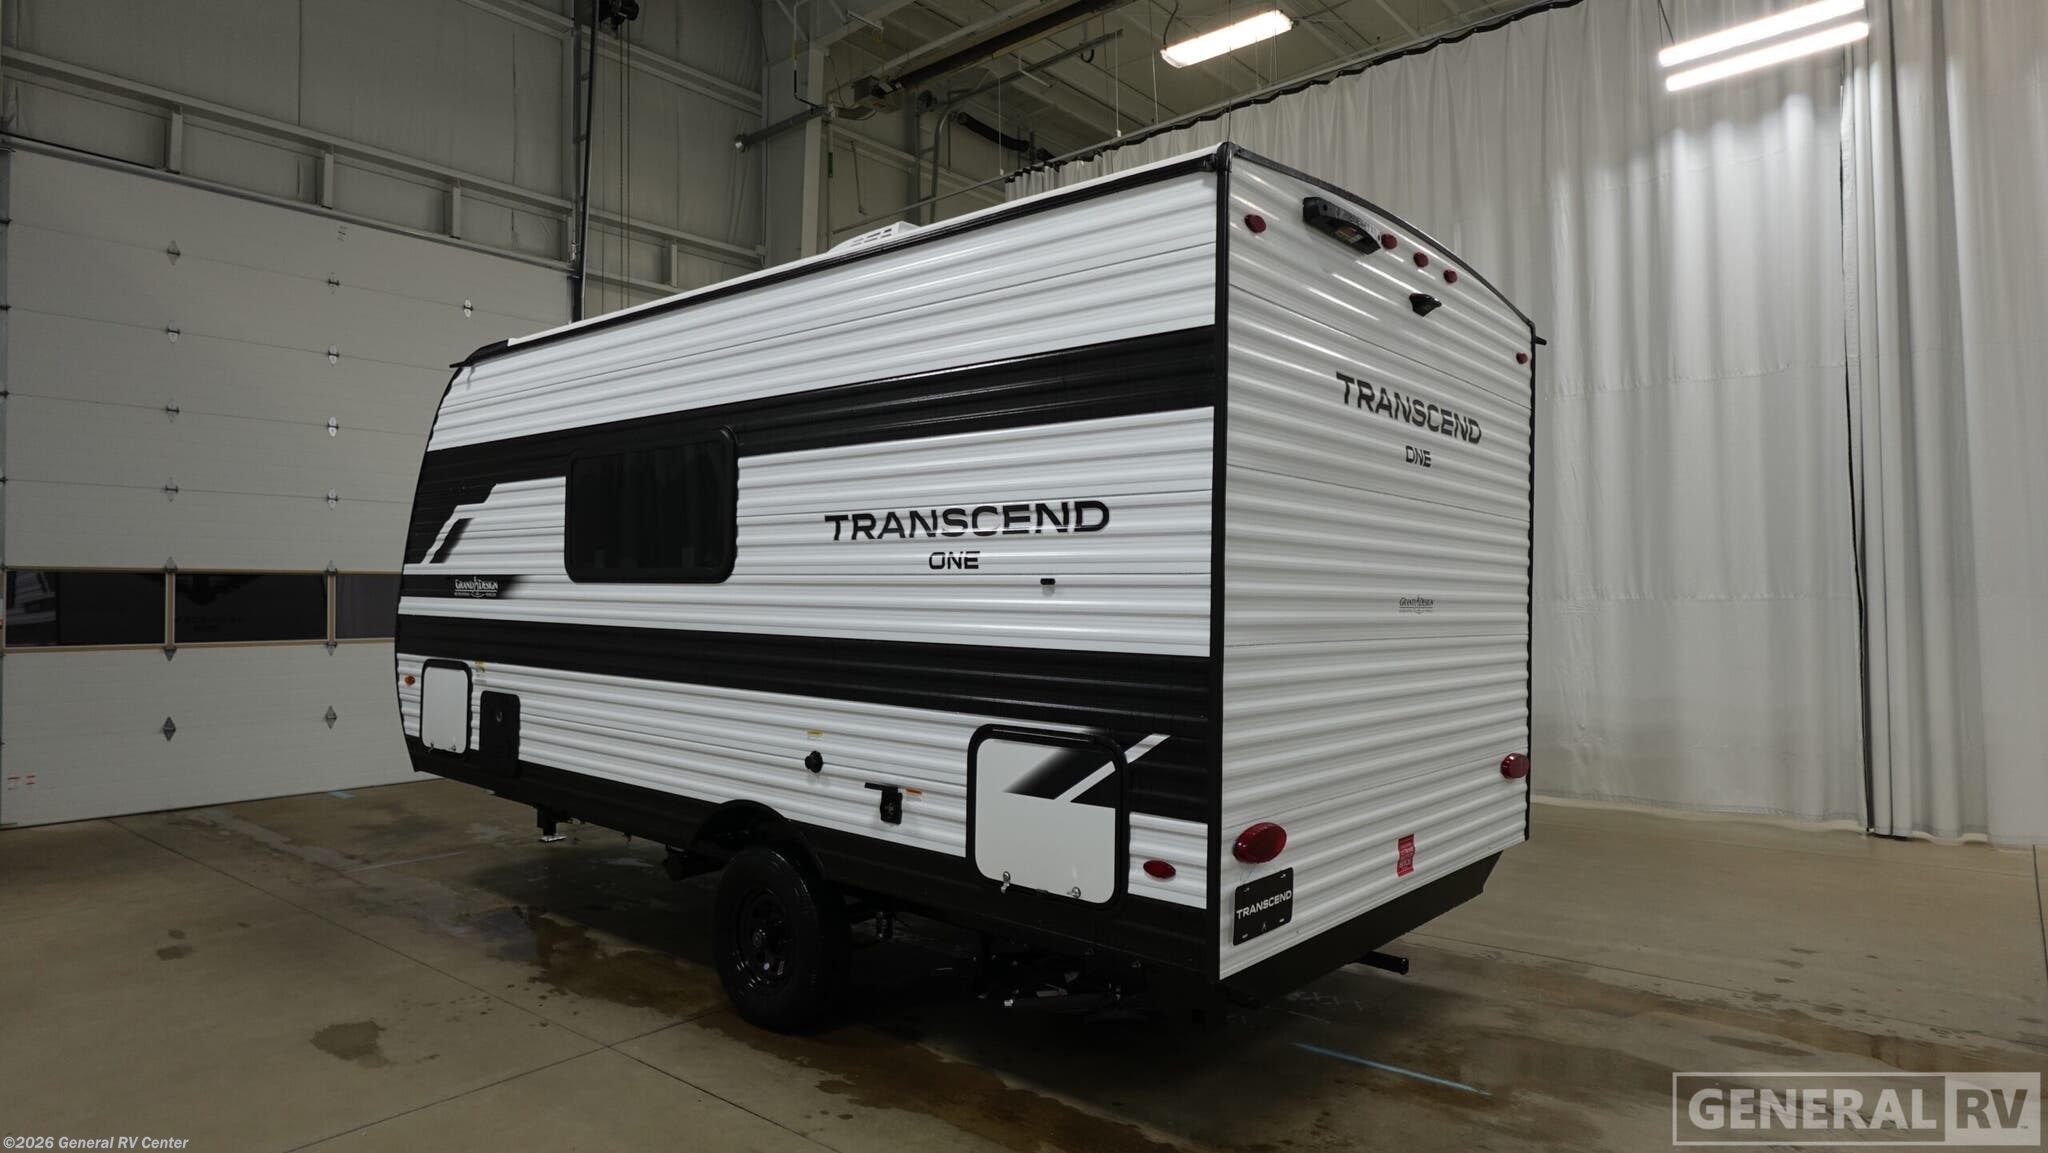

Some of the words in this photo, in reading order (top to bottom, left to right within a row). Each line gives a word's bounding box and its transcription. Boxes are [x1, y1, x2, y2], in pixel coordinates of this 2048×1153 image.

[1336, 371, 1482, 445] TRANSCEND
[1405, 445, 1432, 468] ONE
[824, 500, 1110, 541] TRANSCEND
[928, 551, 981, 570] ONE
[1236, 890, 1292, 919] TRANSCEND
